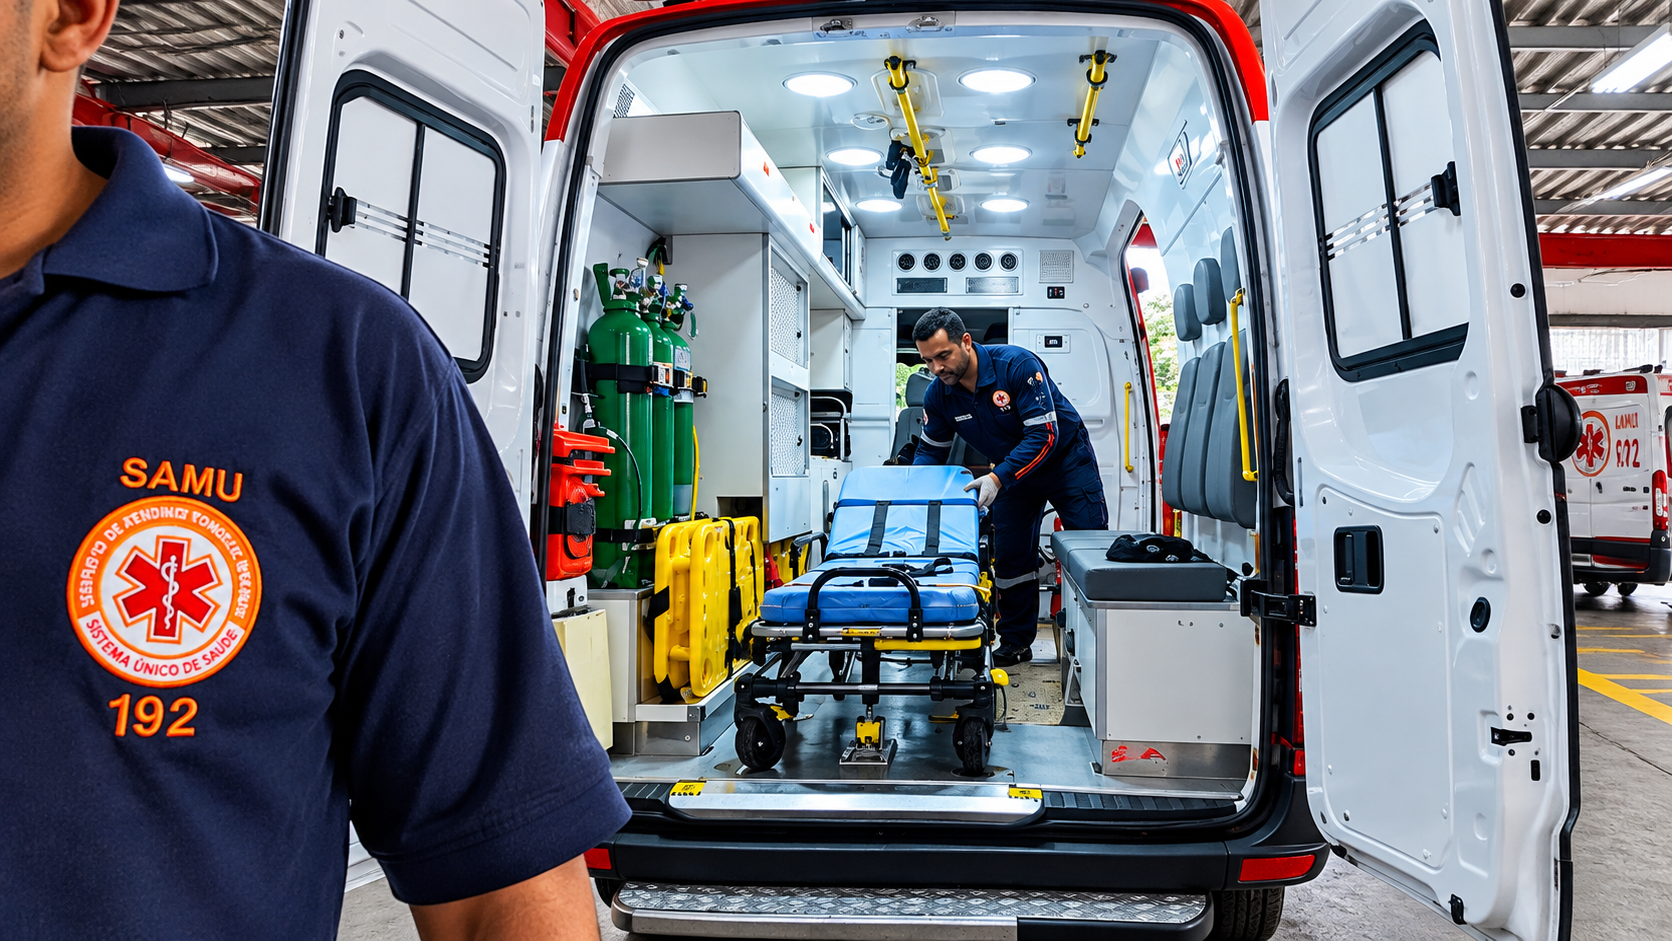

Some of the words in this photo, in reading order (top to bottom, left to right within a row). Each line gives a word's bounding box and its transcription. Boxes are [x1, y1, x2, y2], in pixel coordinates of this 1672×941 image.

[119, 456, 243, 502] SAMU
[103, 522, 124, 542] DE
[86, 619, 130, 668] SISTEMA
[133, 658, 179, 677] ÚNICO
[183, 658, 201, 674] DE
[202, 628, 238, 666] SAÚDE
[108, 693, 198, 737] 192
